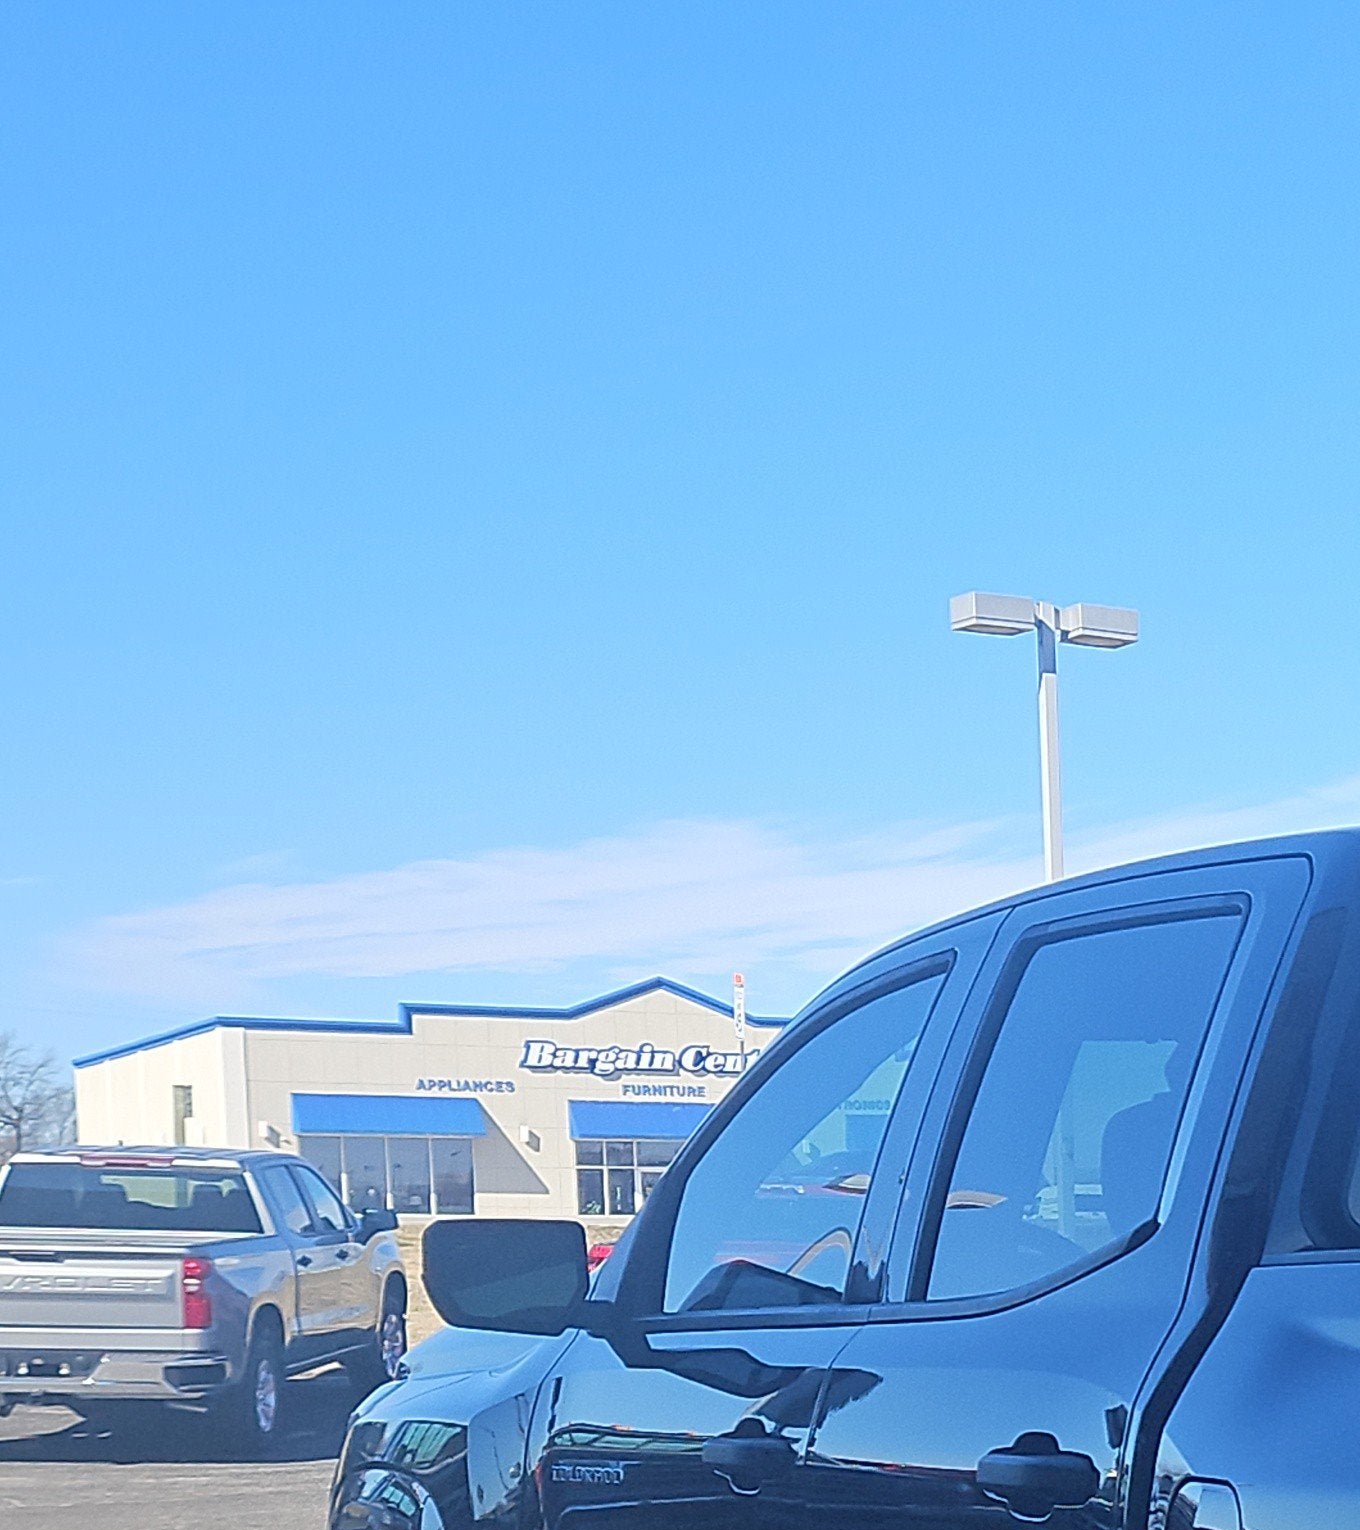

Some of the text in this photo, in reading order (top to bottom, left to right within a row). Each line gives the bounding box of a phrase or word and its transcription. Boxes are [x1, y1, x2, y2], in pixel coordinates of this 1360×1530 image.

[521, 1040, 676, 1078] Bargain
[416, 1078, 516, 1094] APPLIANCES
[622, 1083, 706, 1098] FURNITURE
